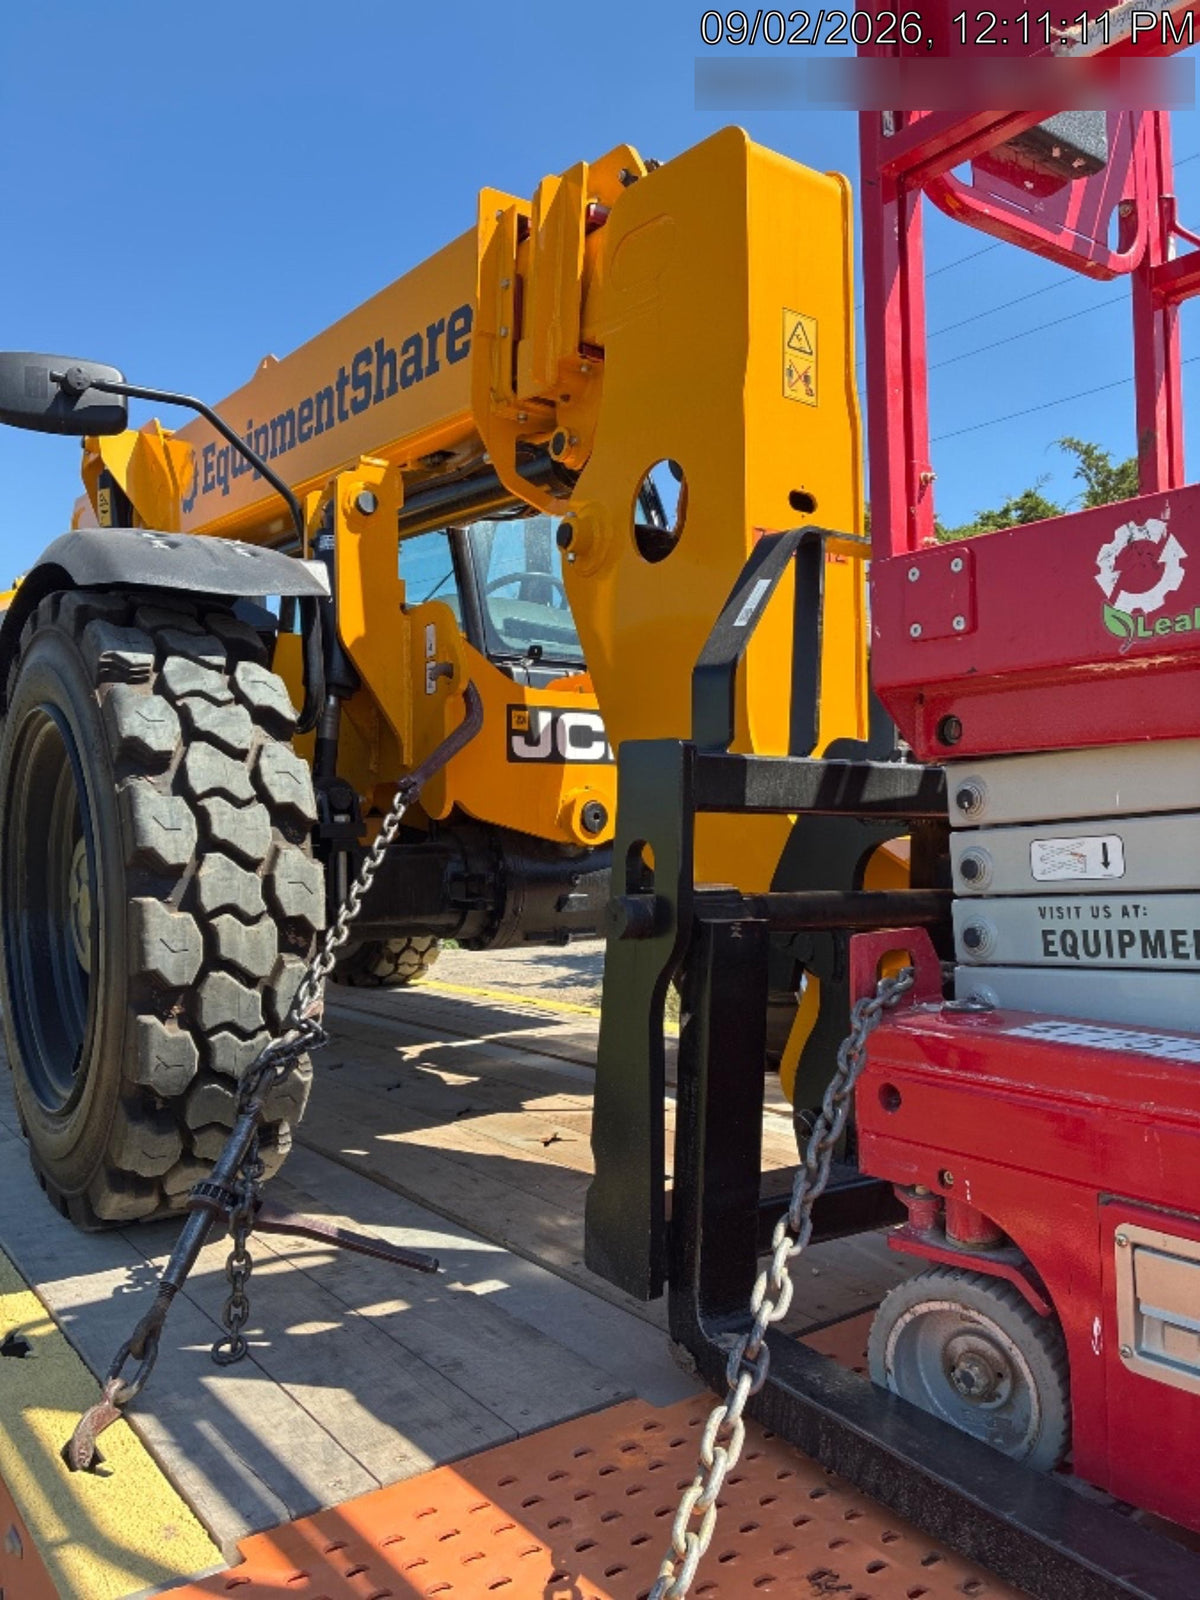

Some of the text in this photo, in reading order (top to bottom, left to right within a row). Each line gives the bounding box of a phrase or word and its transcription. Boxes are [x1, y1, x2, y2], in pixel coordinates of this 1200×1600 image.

[202, 303, 474, 497] EquipmentShare
[511, 710, 615, 760] JC
[1038, 904, 1148, 919] VISIT US AT:
